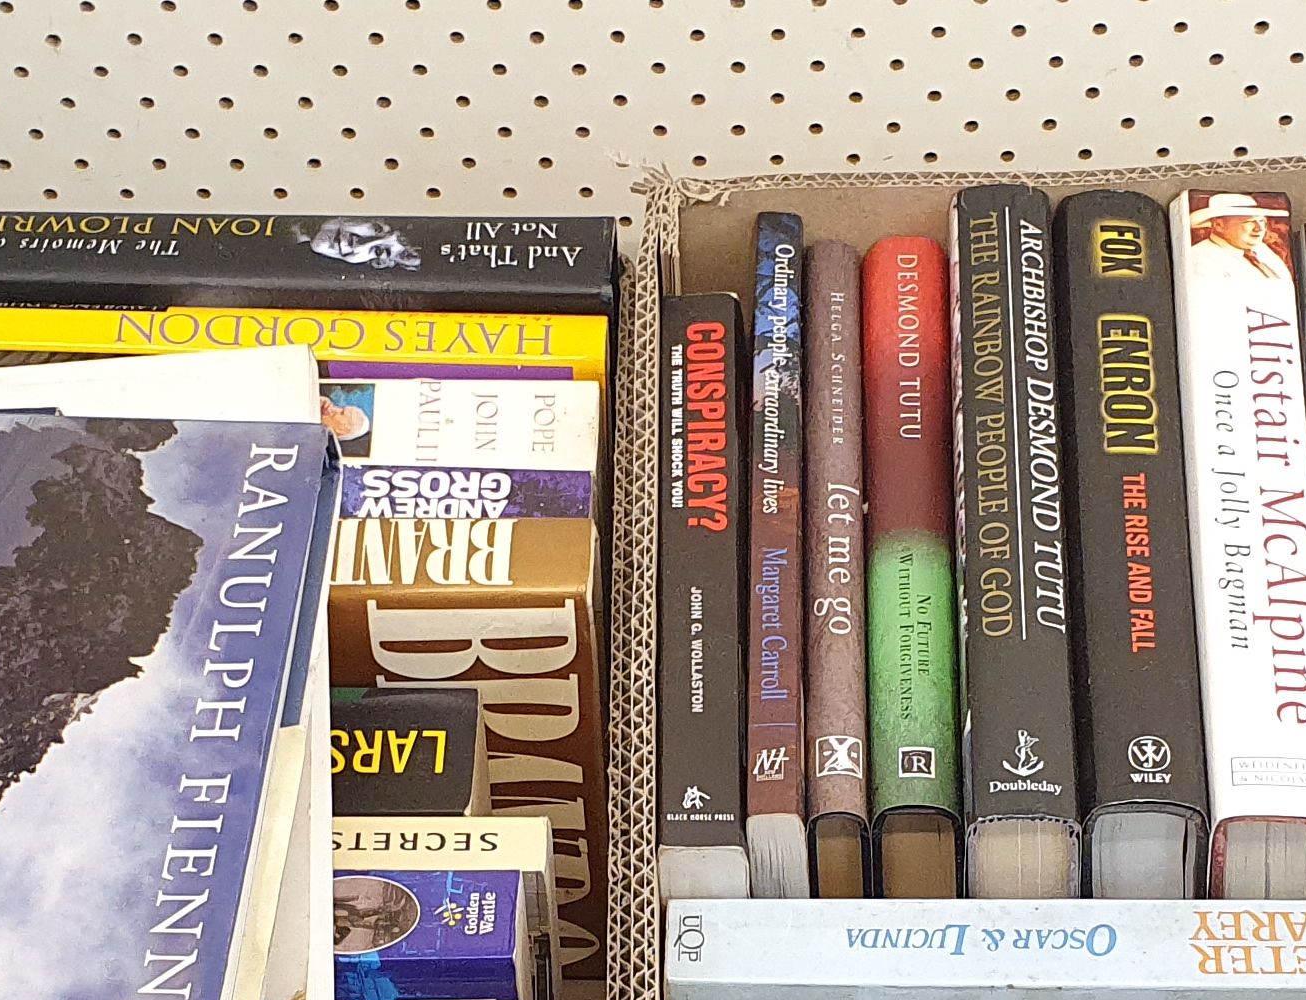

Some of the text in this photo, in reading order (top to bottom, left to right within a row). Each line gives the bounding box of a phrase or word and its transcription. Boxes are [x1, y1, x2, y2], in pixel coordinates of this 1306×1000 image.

[18, 238, 121, 255] Memoirs
[136, 239, 179, 256] The
[171, 213, 279, 238] JOAN
[466, 222, 558, 240] Not All
[440, 244, 583, 268] And That's
[114, 312, 553, 356] HAYES GORDON
[758, 244, 795, 514] Ordinary people extraordinary lives
[1099, 318, 1157, 451] ENRON
[1246, 306, 1300, 467] Alistair
[416, 380, 443, 439] PAUL
[472, 392, 499, 452] JOHN
[532, 393, 556, 453] POPE
[671, 345, 683, 508] THE TRUTH WILL SHOCK YOU!
[686, 321, 728, 532] CONSPIRACY?
[355, 497, 509, 519] ANDREW
[362, 468, 512, 500] GROSS
[1211, 370, 1251, 649] Once a Jolly Bagman
[814, 482, 859, 634] let me go
[188, 441, 299, 742] RANULPH
[691, 587, 703, 713] JOHN G. WOLLASTON
[756, 548, 788, 700] Margaret Carroll
[989, 780, 1063, 796] Doubleday
[1129, 773, 1172, 784] WILEY
[464, 892, 480, 936] Golden
[479, 890, 496, 935] Wattle
